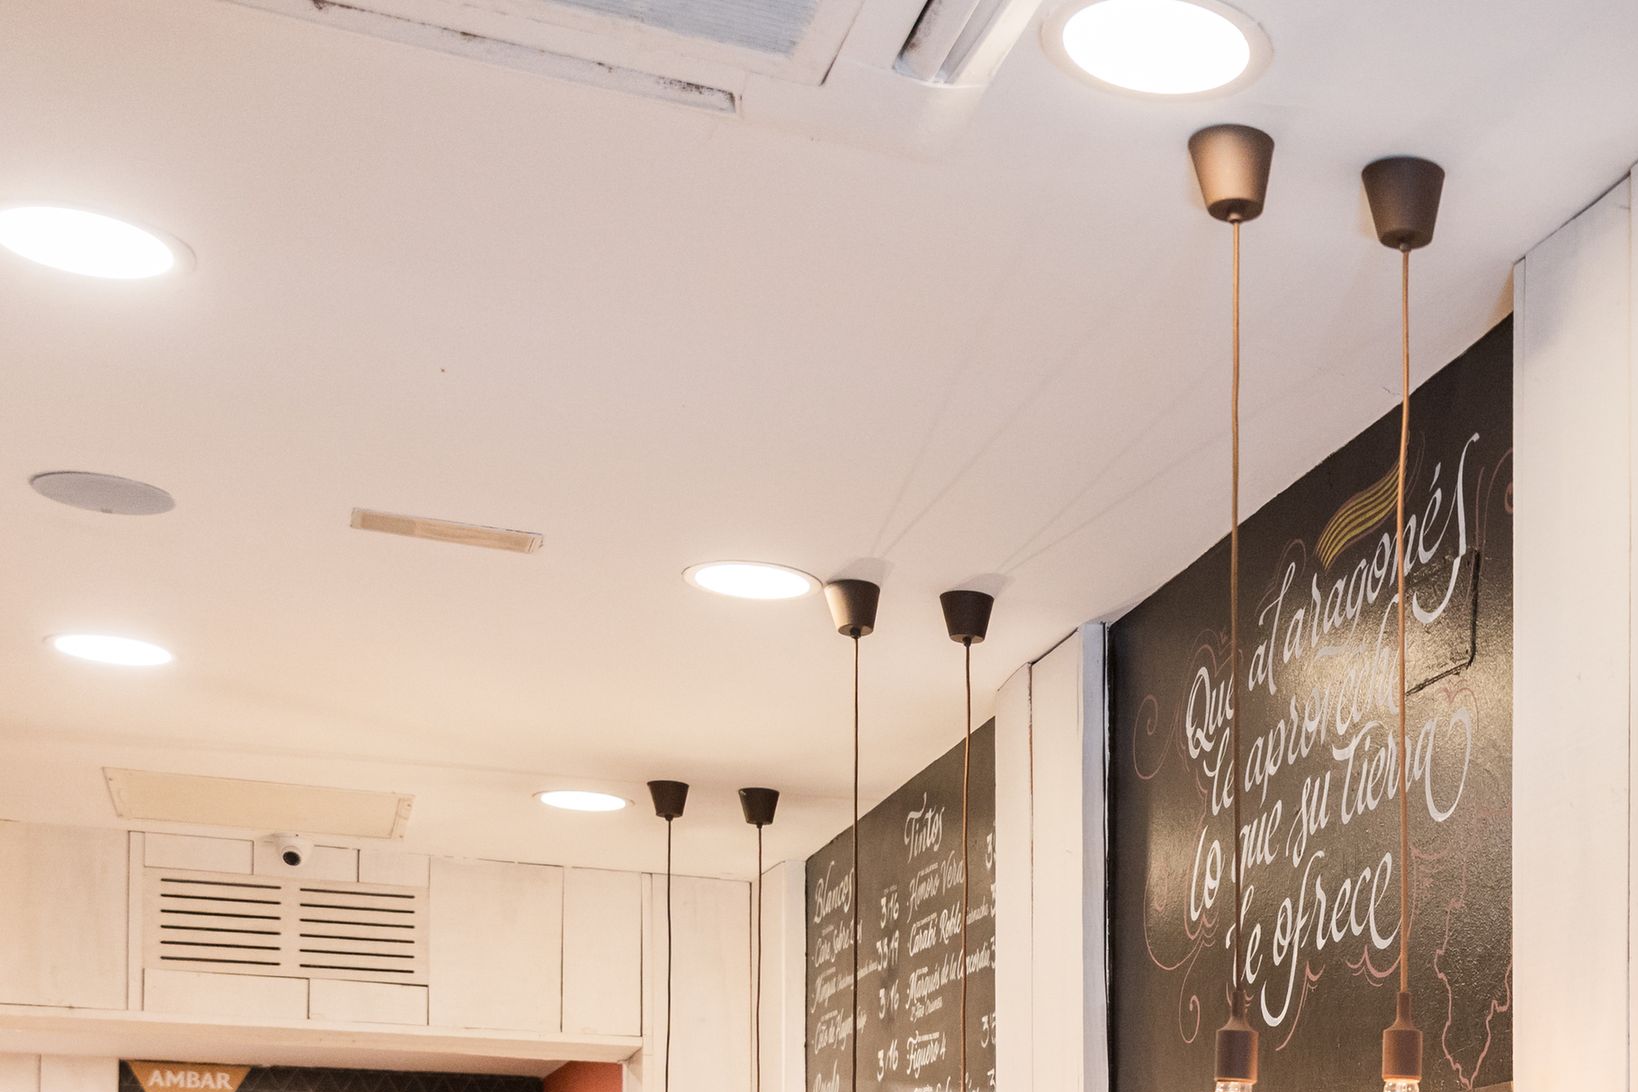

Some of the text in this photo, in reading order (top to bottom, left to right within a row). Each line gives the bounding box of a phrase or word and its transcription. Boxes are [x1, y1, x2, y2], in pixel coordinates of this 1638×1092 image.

[904, 792, 946, 864] Tintos
[1261, 850, 1402, 1028] ofrece
[146, 1070, 235, 1091] AMBAR
